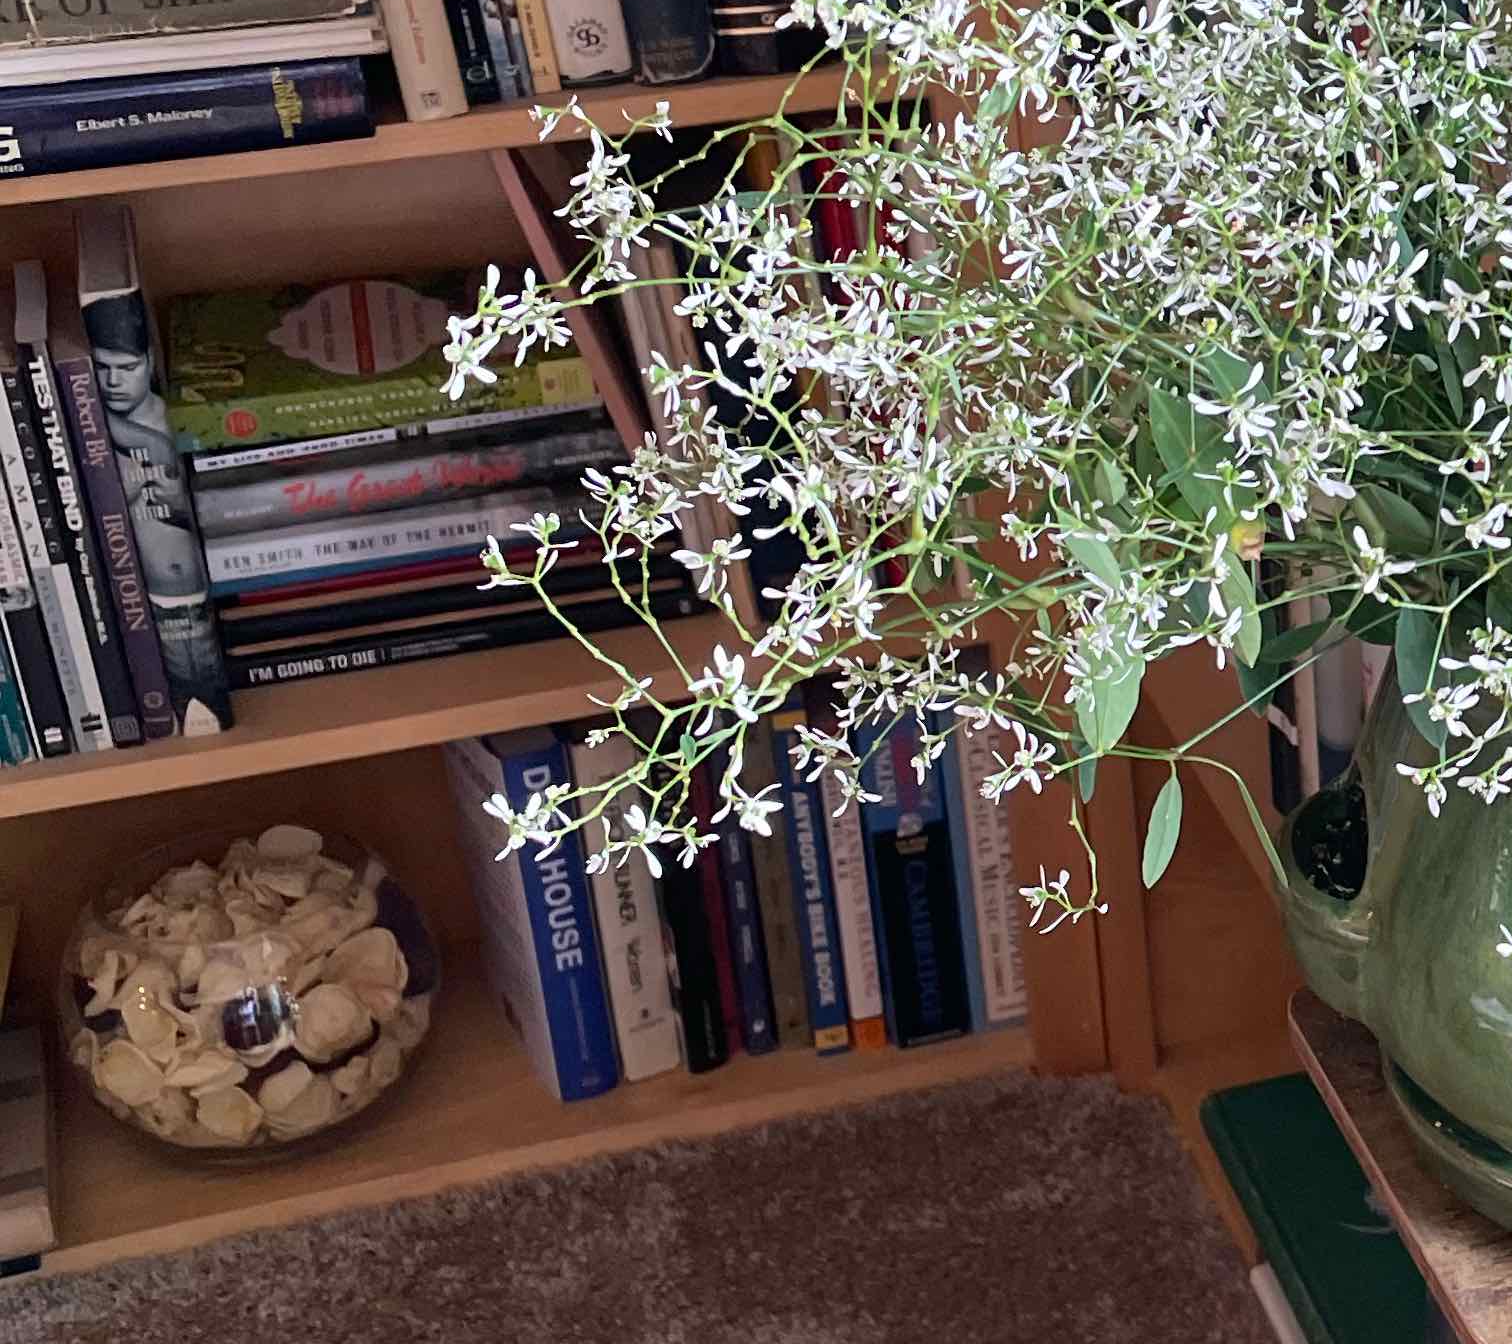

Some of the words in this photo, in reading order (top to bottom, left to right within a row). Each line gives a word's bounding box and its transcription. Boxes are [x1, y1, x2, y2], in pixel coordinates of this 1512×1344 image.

[76, 120, 126, 133] Elbert
[128, 116, 145, 129] S.
[147, 107, 214, 126] Maloney
[69, 372, 98, 434] Robert
[4, 377, 60, 554] BECOMING
[28, 355, 54, 410] TIES
[41, 410, 70, 473] THAT
[56, 475, 84, 532] BIND
[207, 458, 227, 467] MY
[102, 512, 131, 569] IRON
[222, 555, 251, 570] KEN
[256, 549, 304, 565] SMITH
[314, 542, 340, 557] THE
[348, 538, 375, 552] WAY
[381, 534, 398, 547] OF
[404, 528, 432, 542] THE
[438, 519, 492, 538] HERMIT
[112, 568, 149, 632] JOHN
[249, 666, 273, 683] I'M
[277, 659, 325, 679] GOING
[328, 655, 349, 670] TO
[352, 648, 377, 665] DIE
[790, 790, 823, 900] ANYBODY'S
[539, 857, 584, 973] HOUSE
[807, 902, 829, 949] BIKE
[814, 952, 836, 1007] BOOK
